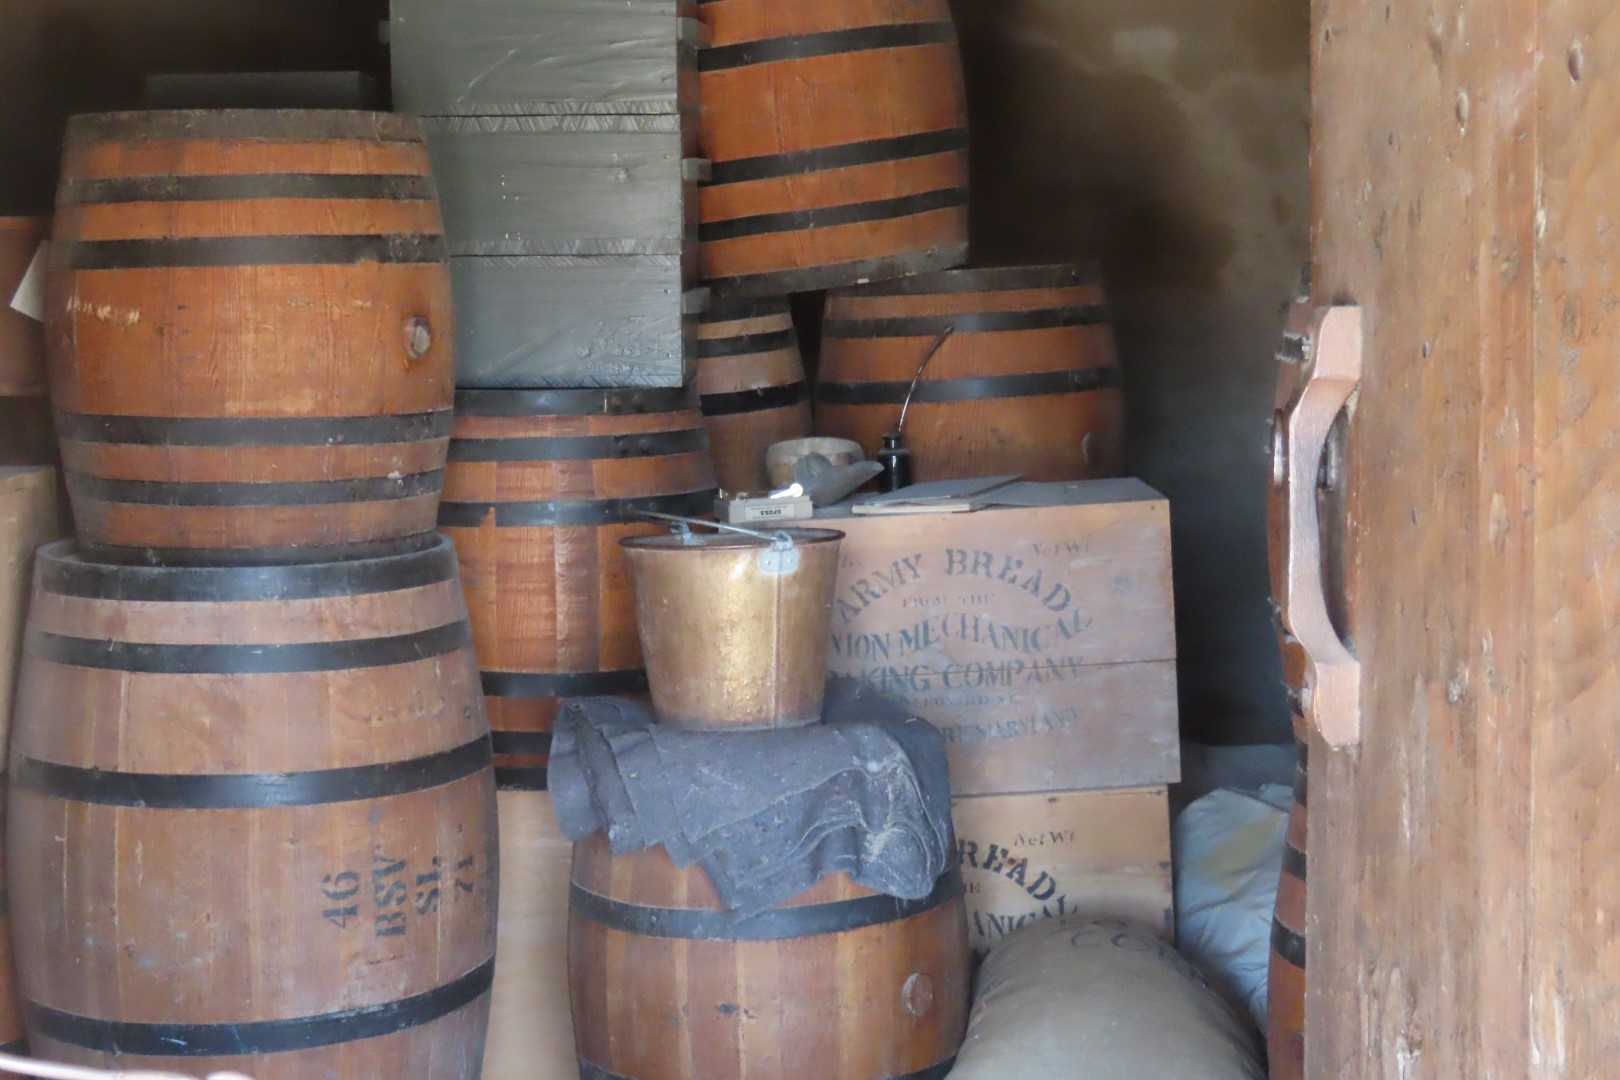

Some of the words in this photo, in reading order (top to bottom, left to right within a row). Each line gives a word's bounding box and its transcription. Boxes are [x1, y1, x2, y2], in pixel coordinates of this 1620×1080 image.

[836, 553, 923, 626] ARMY
[945, 548, 1072, 612] BREAD
[958, 594, 995, 606] THE
[829, 630, 890, 662] NION
[899, 608, 1093, 657] MECHANICAL
[827, 663, 929, 694] KING
[942, 656, 1085, 689] COMPANY
[975, 707, 1079, 740] MARYLAND
[1014, 832, 1045, 847] Net
[1049, 829, 1076, 845] Wt
[372, 854, 407, 938] BSV
[957, 838, 1057, 901] READ
[322, 870, 360, 929] 46
